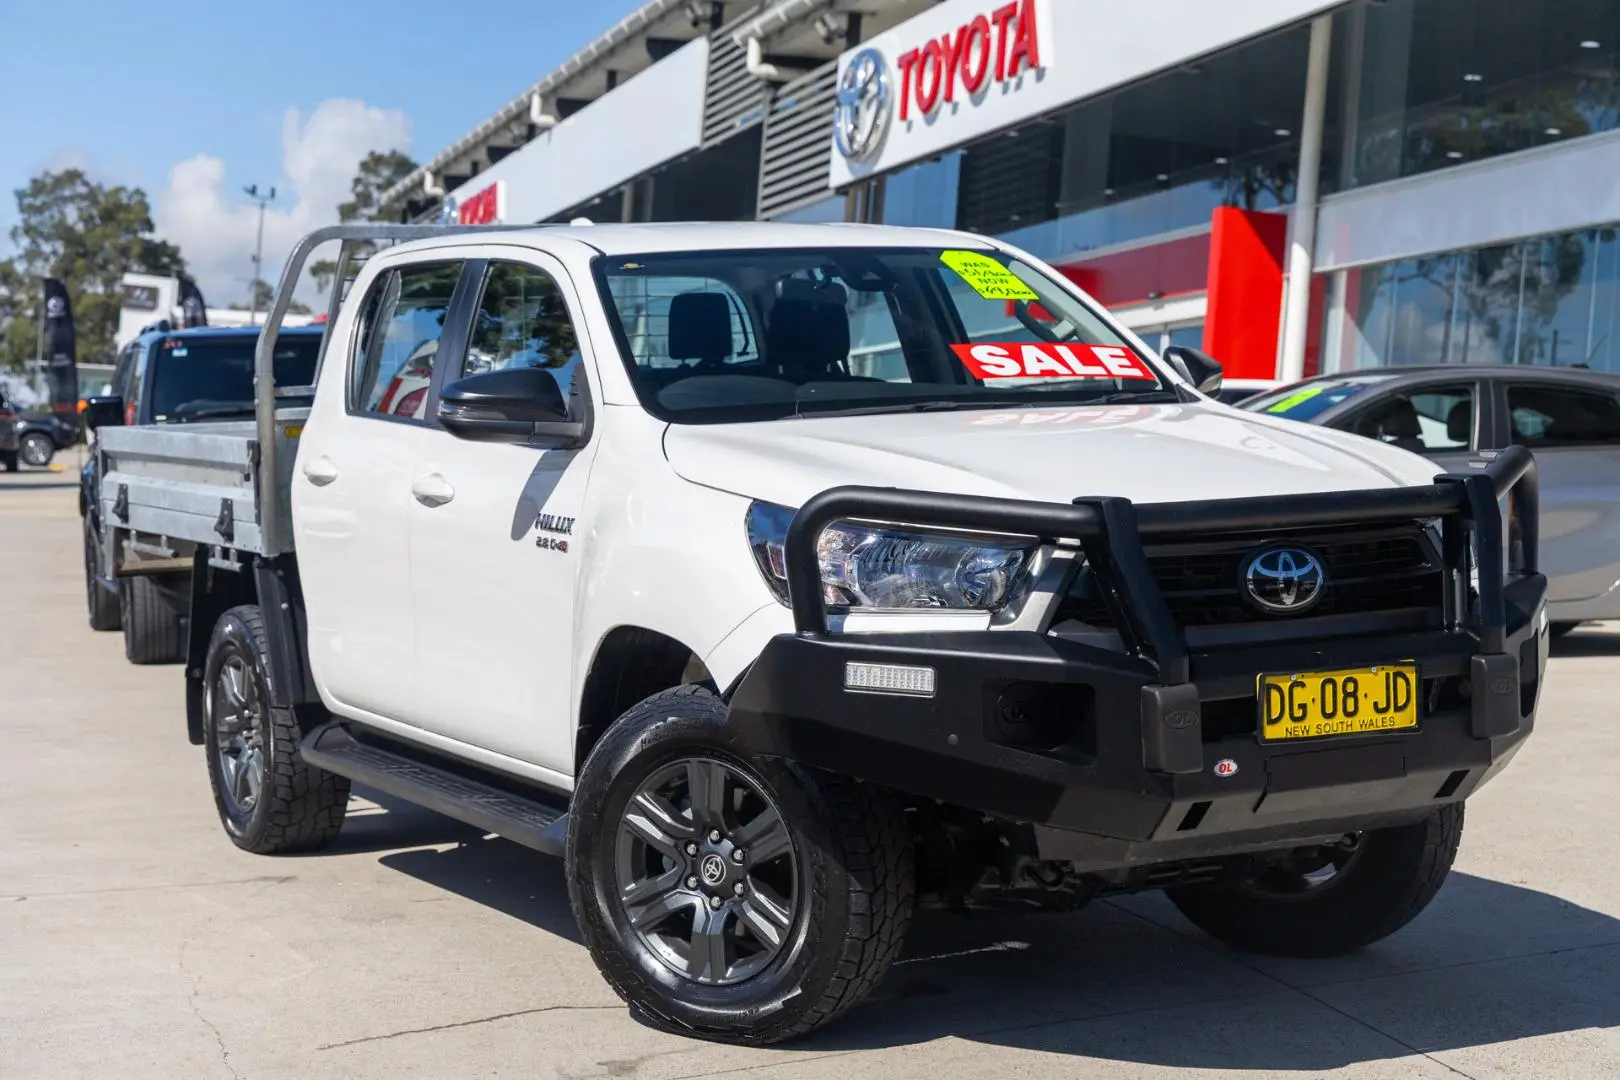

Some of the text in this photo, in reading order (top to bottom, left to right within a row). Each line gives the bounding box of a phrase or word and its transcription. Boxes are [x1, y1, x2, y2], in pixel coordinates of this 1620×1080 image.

[897, 0, 1039, 121] TOYOTA
[970, 344, 1144, 377] SALE
[535, 512, 575, 535] HILUX
[1285, 716, 1396, 738] NEW SOUTH WALES
